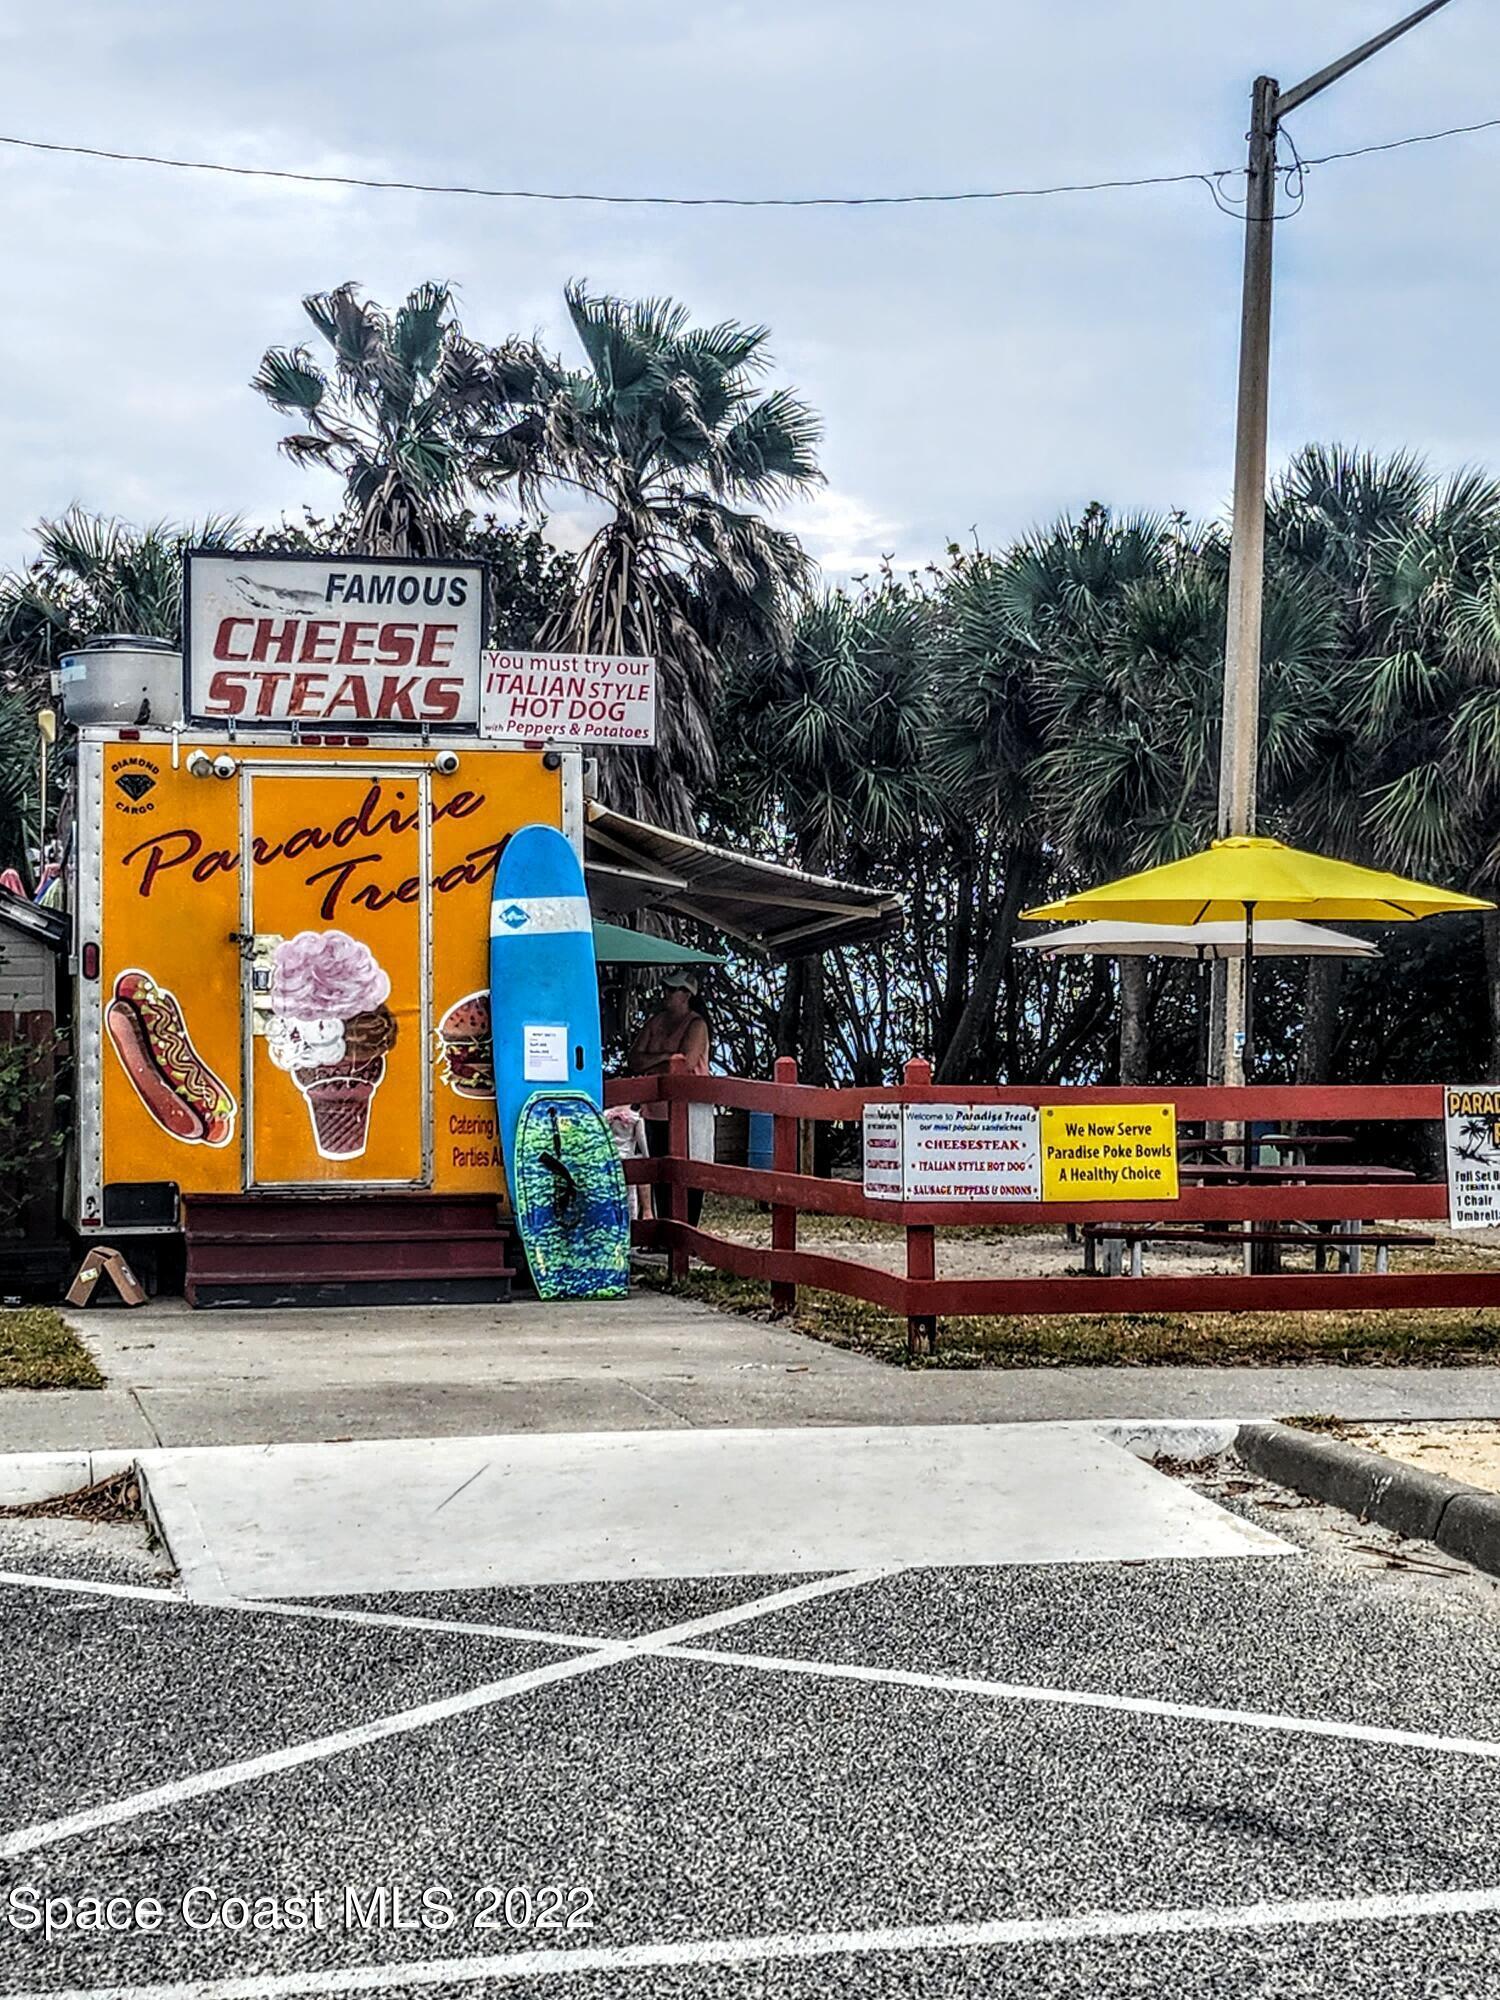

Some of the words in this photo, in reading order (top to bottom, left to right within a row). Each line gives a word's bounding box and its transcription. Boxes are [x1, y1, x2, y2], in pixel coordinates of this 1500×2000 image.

[325, 573, 468, 607] FAMOUS
[213, 616, 458, 668] CHEESE
[488, 652, 524, 670] You
[530, 656, 579, 673] must
[585, 658, 610, 679] try
[616, 662, 650, 676] our
[204, 670, 464, 721] STEAKS
[486, 672, 586, 698] ITALIAN
[588, 682, 650, 701] STYLE
[510, 697, 564, 719] HOT
[568, 700, 626, 722] DOG
[484, 722, 504, 732] with
[506, 720, 566, 737] Peppers
[569, 723, 581, 736] &
[584, 724, 649, 739] Potatoes
[111, 757, 160, 775] DIAMOND
[115, 801, 155, 815] CARGO
[122, 785, 486, 897] Paradise
[905, 1111, 944, 1121] Welcome
[945, 1112, 954, 1121] to
[955, 1110, 1003, 1122] Paradise
[1004, 1111, 1037, 1123] Treats
[449, 1114, 494, 1140] Catering
[919, 1123, 931, 1132] our
[932, 1123, 952, 1132] most
[952, 1123, 980, 1133] popular
[981, 1123, 1023, 1132] sandwiches
[1065, 1122, 1085, 1137] We
[1087, 1122, 1116, 1137] Now
[1117, 1122, 1152, 1136] Serve
[924, 1139, 1020, 1150] CHEESESTEAK
[1047, 1144, 1100, 1160] Paradise
[1103, 1143, 1133, 1159] Poke
[1135, 1143, 1172, 1158] Bowls
[452, 1146, 489, 1168] Parties
[918, 1161, 956, 1172] ITALIAN
[957, 1161, 986, 1172] STYLE
[986, 1161, 1006, 1172] HOT
[1006, 1162, 1026, 1172] DOG
[1058, 1167, 1068, 1182] A
[1070, 1166, 1119, 1184] Healthy
[1121, 1165, 1162, 1180] Choice
[913, 1184, 952, 1196] SAUSAGE
[953, 1184, 990, 1196] PEPPERS
[1000, 1184, 1032, 1196] ONIONS
[1456, 1195, 1462, 1207] 1
[1463, 1194, 1493, 1207] Chair
